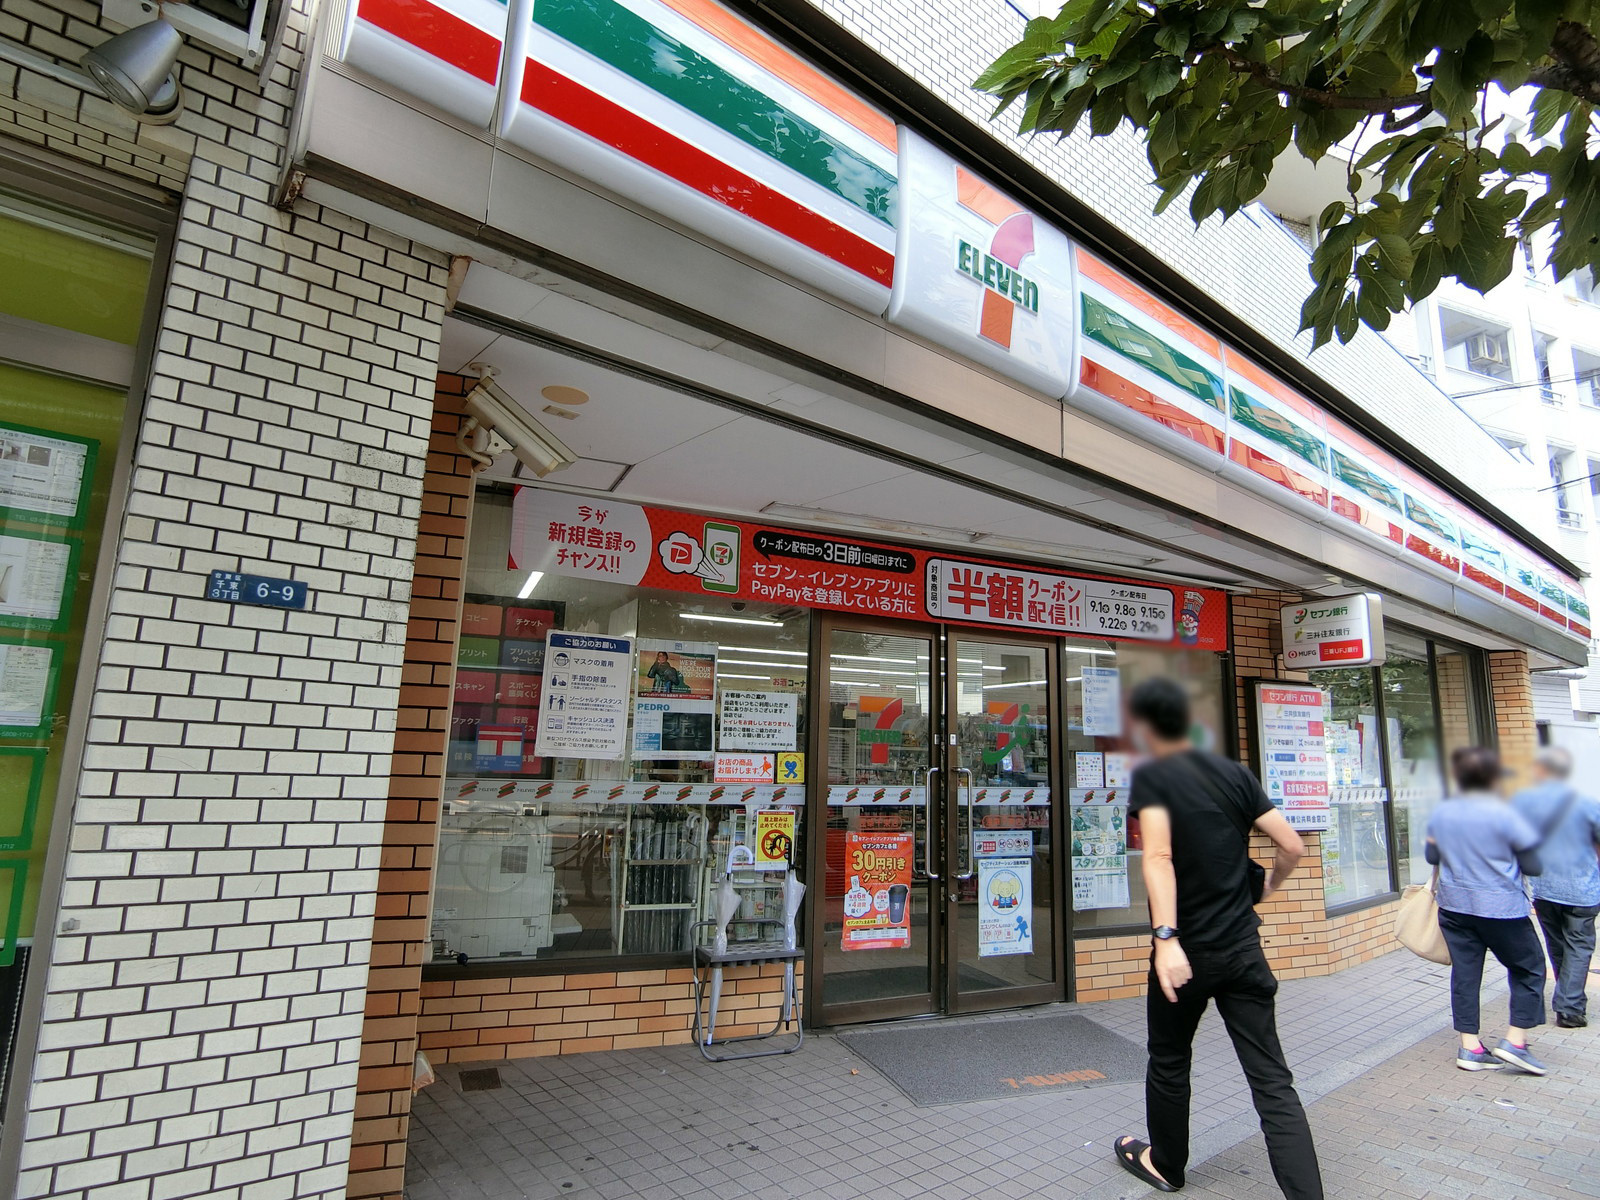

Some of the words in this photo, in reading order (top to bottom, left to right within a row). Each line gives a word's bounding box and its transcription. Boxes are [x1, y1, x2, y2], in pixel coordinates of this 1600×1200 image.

[577, 505, 609, 525] 今が
[548, 521, 637, 553] 新規登録の
[557, 548, 621, 574] チャンス!!
[216, 580, 239, 590] 千束
[930, 565, 938, 609] 対象商品の
[212, 589, 240, 600] 3丁目
[257, 582, 294, 601] 6-9
[948, 567, 1024, 621] 半額
[1028, 579, 1081, 603] クーポン
[1110, 588, 1147, 600] クーポン配布日
[751, 580, 916, 614] PayPayを登録している方に
[465, 613, 489, 622] コピー
[1028, 600, 1080, 627] 配信!!
[1310, 606, 1348, 619] セブン銀行
[515, 618, 543, 627] チケット
[1306, 628, 1350, 640] 三井住友銀行
[564, 638, 617, 650] ご協力のお願い
[459, 648, 488, 657] プリント
[1324, 646, 1359, 655] 三菱UFJ銀行
[511, 656, 541, 665] サービス
[573, 657, 615, 668] マスクの着用
[571, 674, 607, 684] 手指の除菌
[455, 682, 486, 691] スキャン
[507, 682, 539, 691] スポーツ
[569, 696, 623, 706] ソーシャルディスタンス
[725, 692, 767, 700] お客様へのご案内
[1269, 691, 1298, 702] セブン銀行
[1300, 694, 1315, 703] ATM
[637, 703, 670, 712] PEDRO
[512, 715, 529, 725] 行政
[567, 715, 615, 724] キャッシュレス決済
[718, 758, 753, 767] お店の商品
[852, 850, 906, 871] 30円引き
[862, 871, 897, 883] クーポン
